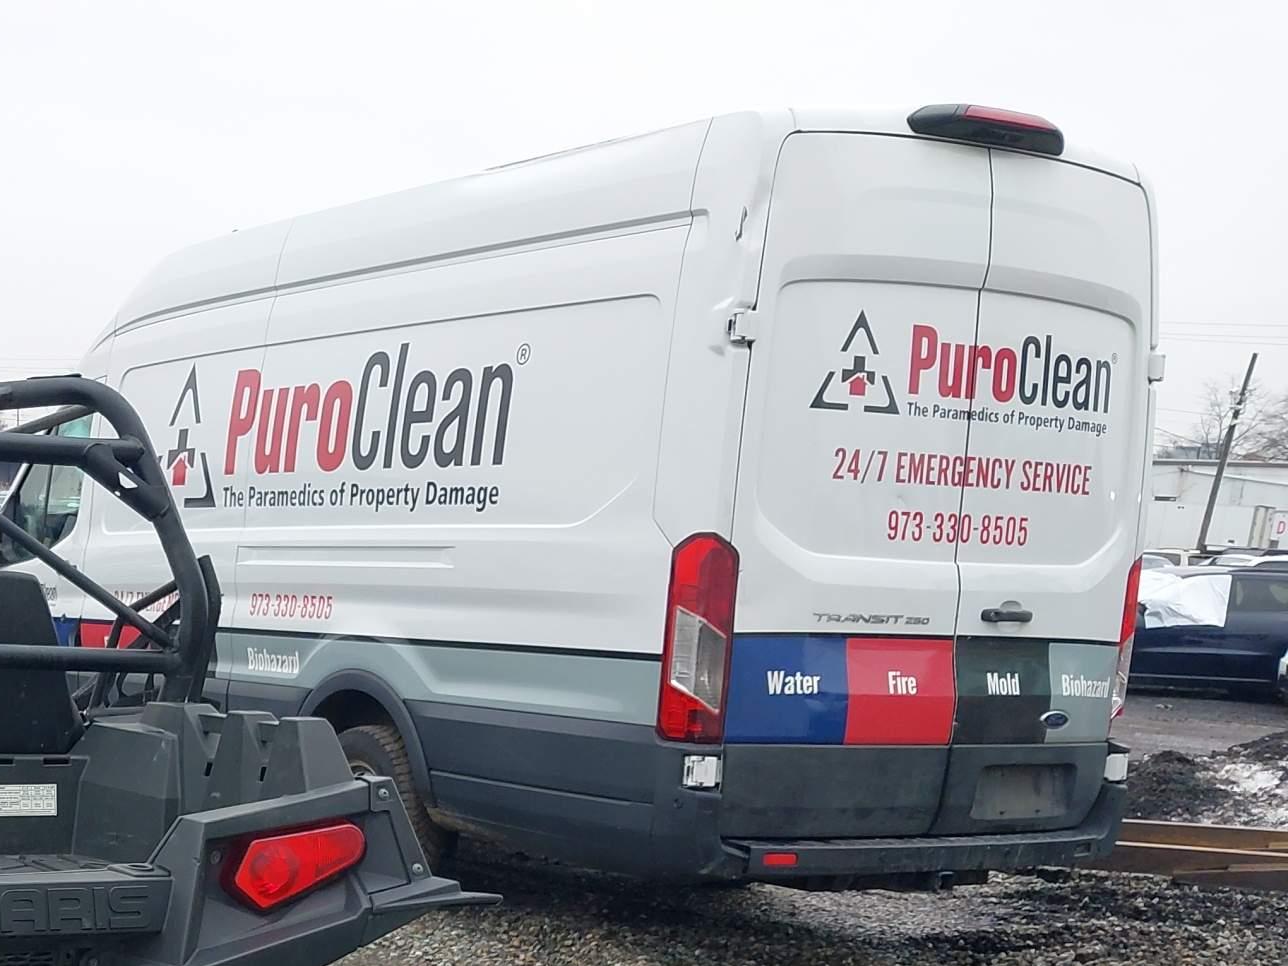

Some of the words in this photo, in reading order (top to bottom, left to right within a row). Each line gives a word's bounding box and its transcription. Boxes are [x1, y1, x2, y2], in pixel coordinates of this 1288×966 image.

[907, 402, 929, 417] The
[933, 404, 999, 424] Paramedics
[1003, 410, 1015, 424] of
[1018, 413, 1065, 433] Property
[1067, 417, 1108, 437] Damage
[832, 447, 889, 484] 24/7
[895, 451, 1016, 490] EMERGENCY
[1020, 460, 1092, 496] SERVICE
[223, 486, 244, 508] The
[248, 482, 325, 508] Paramedics
[329, 481, 347, 507] of
[350, 482, 420, 513] Property
[425, 481, 500, 513] Damage
[887, 510, 1029, 546] 973-330-8505
[249, 592, 333, 620] 973-330-8505
[813, 612, 904, 625] TRANSIT
[247, 647, 300, 674] Biohazard
[767, 671, 821, 695] Water
[888, 670, 917, 695] Fire
[987, 672, 1020, 696] Mold
[1061, 673, 1111, 699] Biohazard
